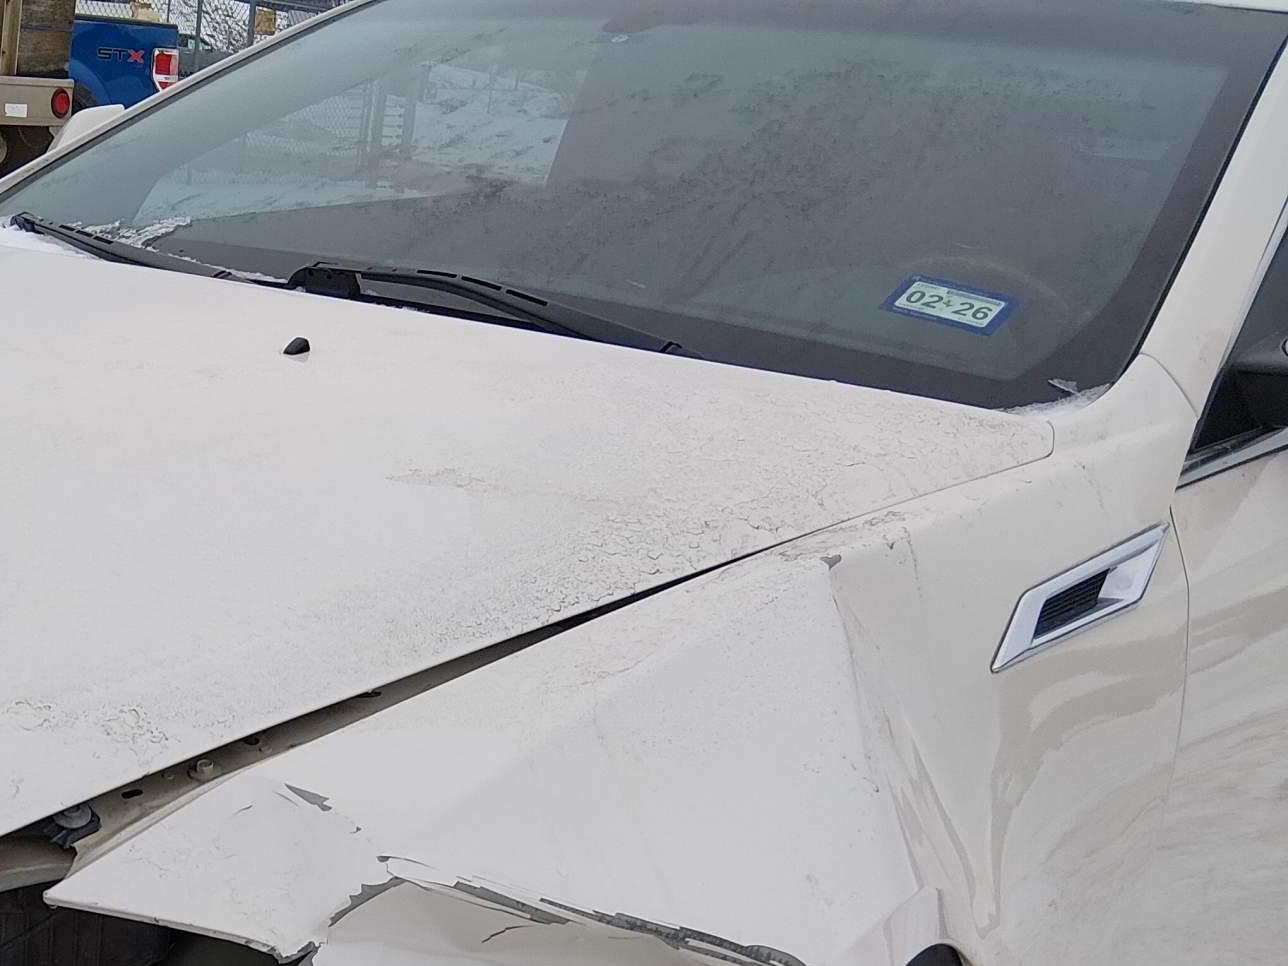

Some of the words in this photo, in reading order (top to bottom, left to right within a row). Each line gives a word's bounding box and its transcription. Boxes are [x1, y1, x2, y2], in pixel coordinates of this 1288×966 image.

[97, 47, 145, 63] STX
[905, 290, 944, 308] 02
[951, 302, 993, 320] 26
